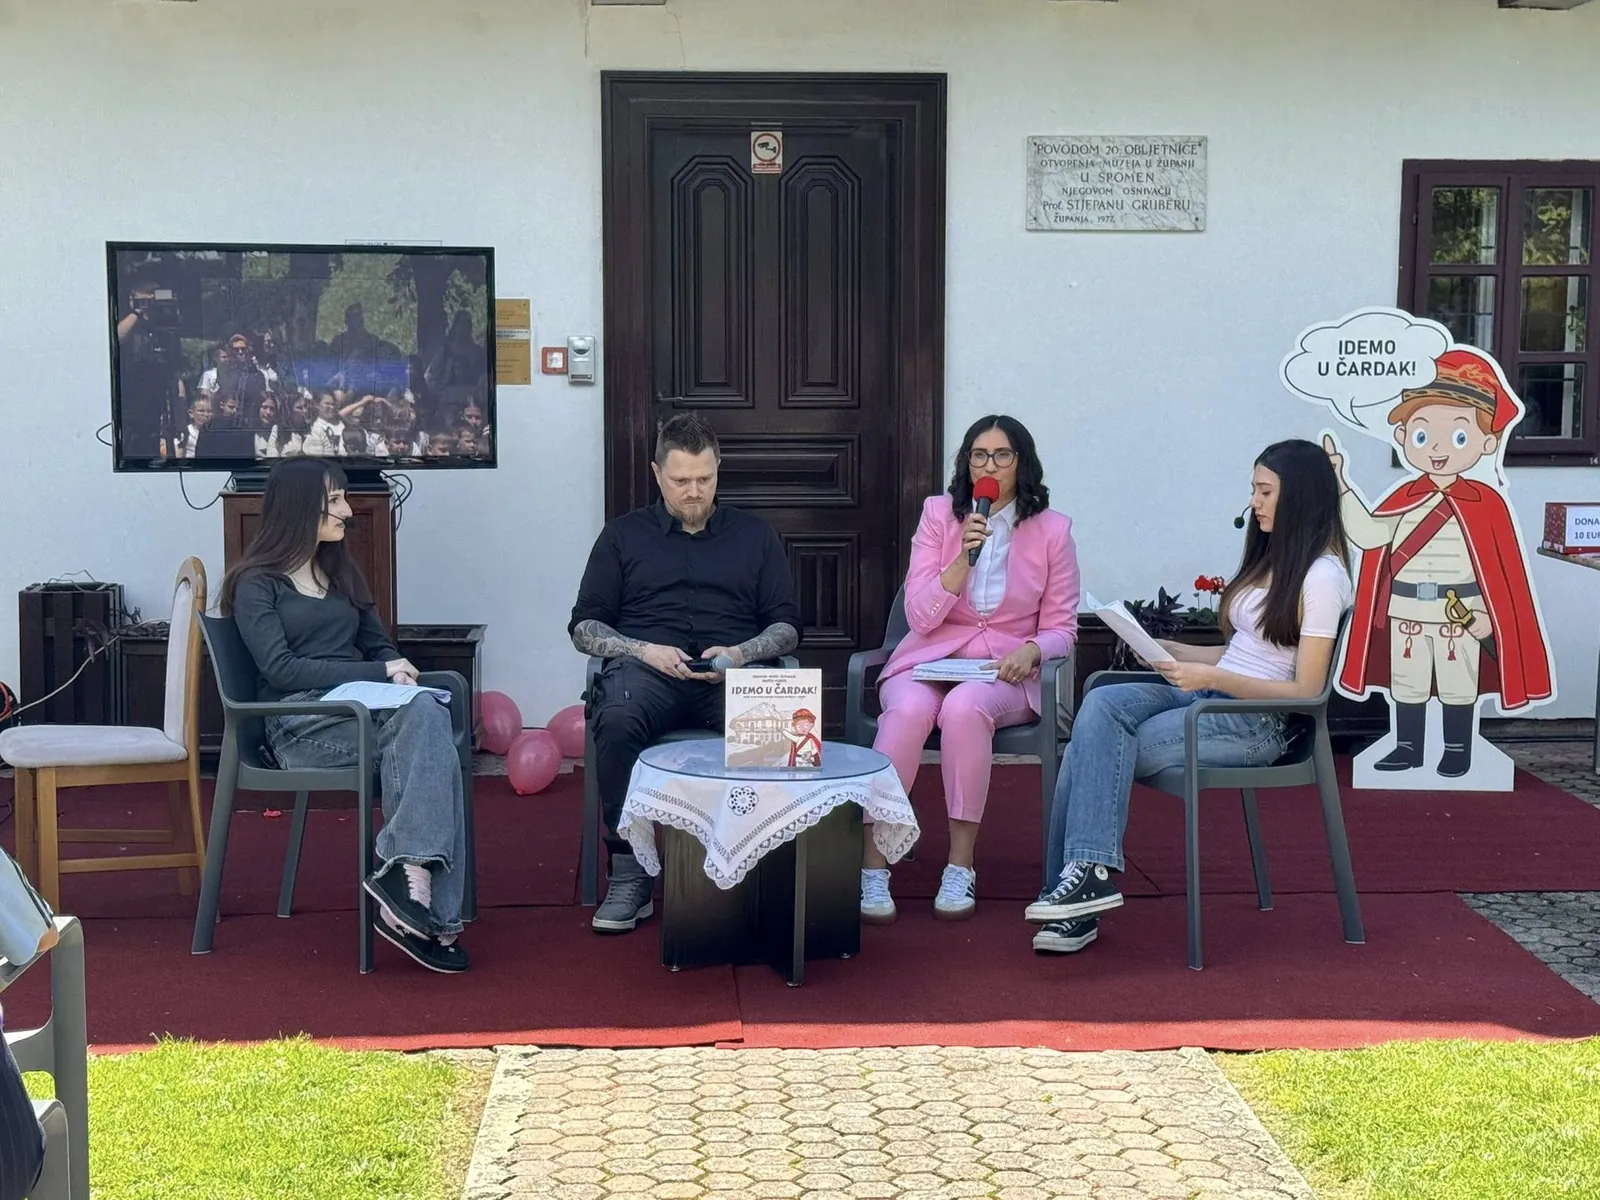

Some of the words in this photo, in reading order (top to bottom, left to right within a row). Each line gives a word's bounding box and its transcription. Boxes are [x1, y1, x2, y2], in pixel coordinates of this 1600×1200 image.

[1037, 144, 1099, 155] POVODOM
[1124, 144, 1198, 156] OBLJETNICE
[1145, 159, 1152, 168] U
[1080, 172, 1089, 183] U
[1098, 172, 1155, 183] SPOMEN
[1062, 187, 1113, 197] NJEGOVOM
[1122, 186, 1171, 196] OSNIVAČU
[1066, 199, 1124, 211] STJEPANU
[1131, 199, 1190, 211] GRUBERU
[1338, 340, 1396, 355] IDEMO
[1317, 362, 1330, 377] U
[1336, 357, 1416, 377] ČARDAK!
[1574, 531, 1585, 539] 10
[731, 686, 763, 695] IDEMO
[765, 686, 772, 695] U
[774, 683, 818, 695] ČARDAK!
